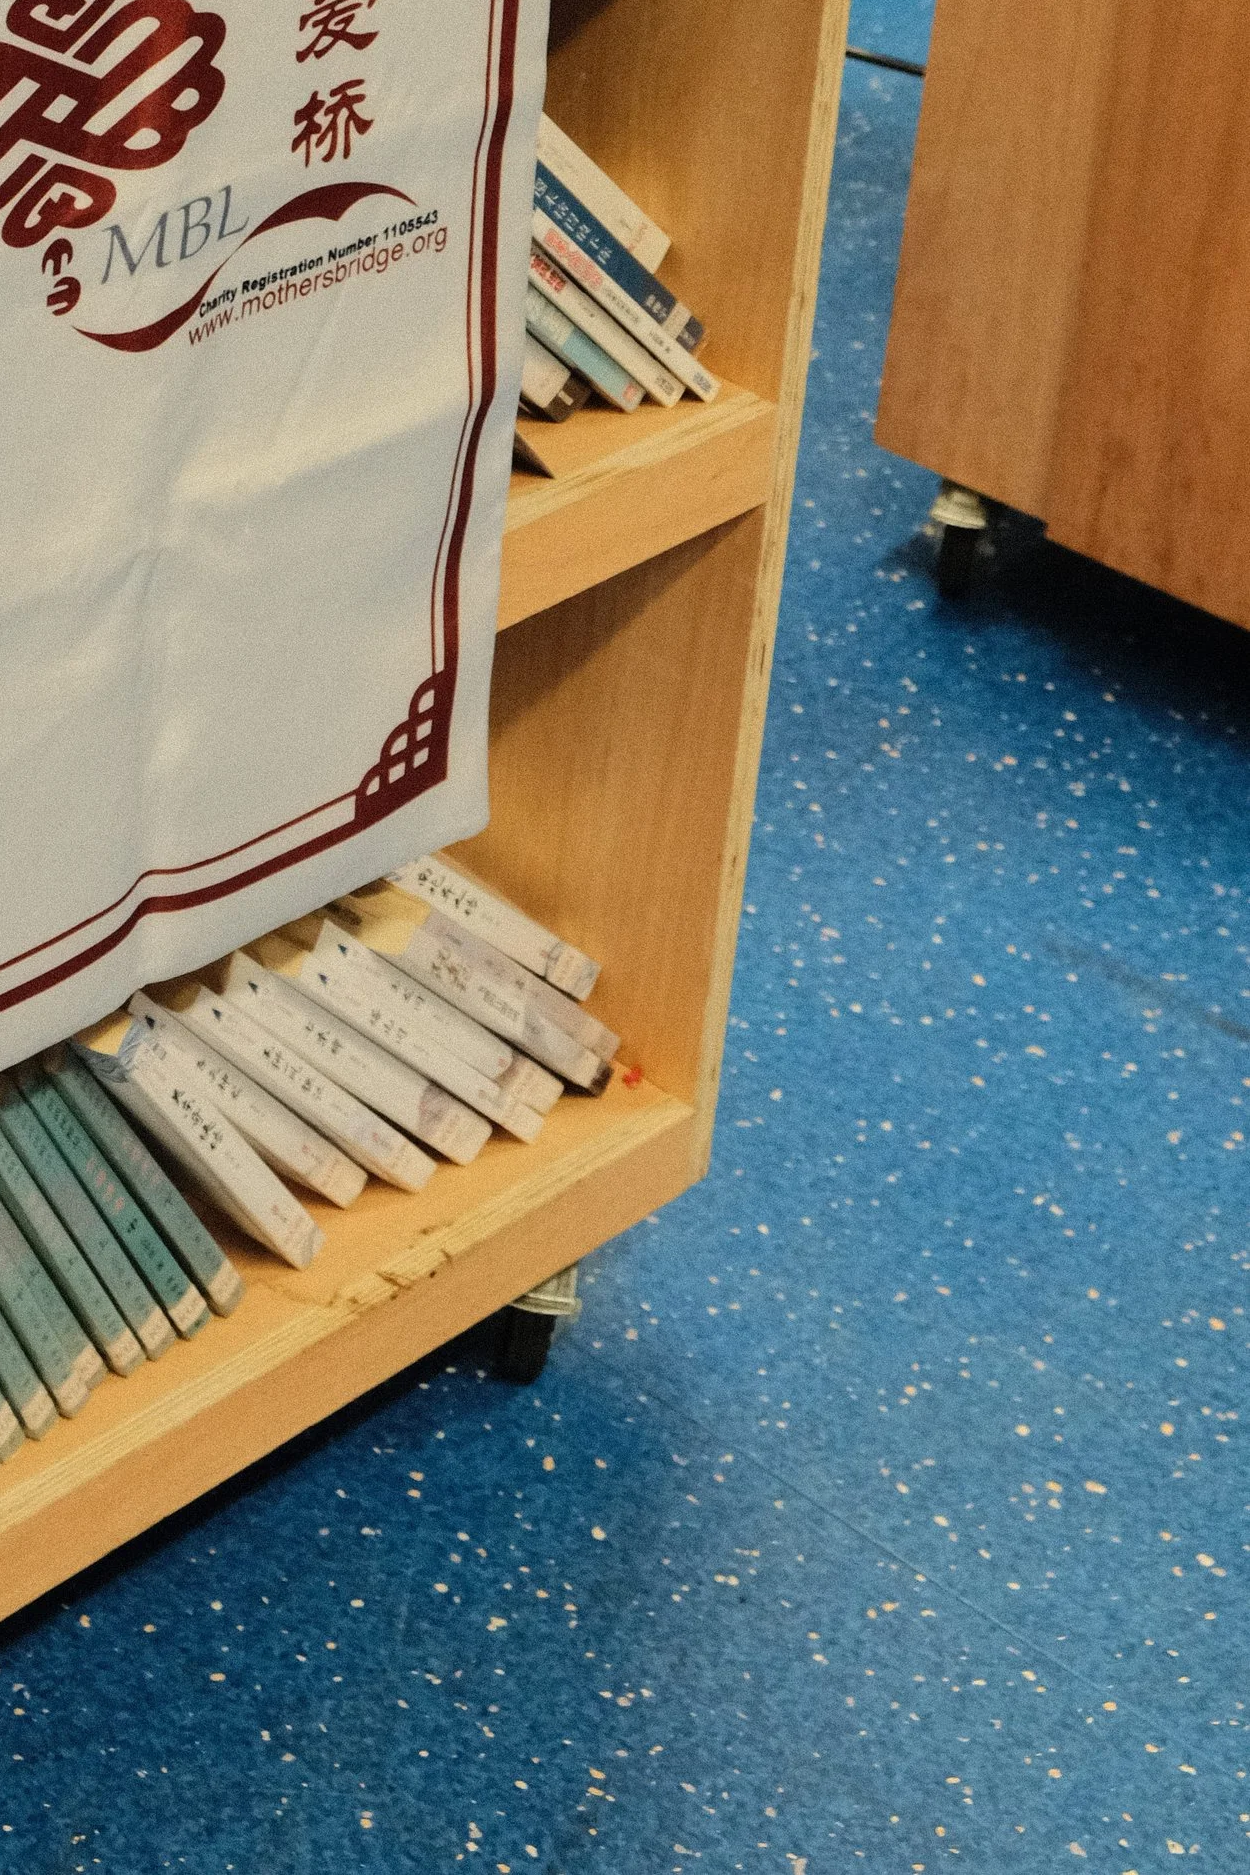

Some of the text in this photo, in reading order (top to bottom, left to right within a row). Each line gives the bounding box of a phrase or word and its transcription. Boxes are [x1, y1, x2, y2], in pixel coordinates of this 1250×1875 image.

[100, 183, 254, 285] MBL
[186, 223, 449, 348] www.mothersbridge.org
[197, 207, 440, 318] Charity Registration Number 1105543
